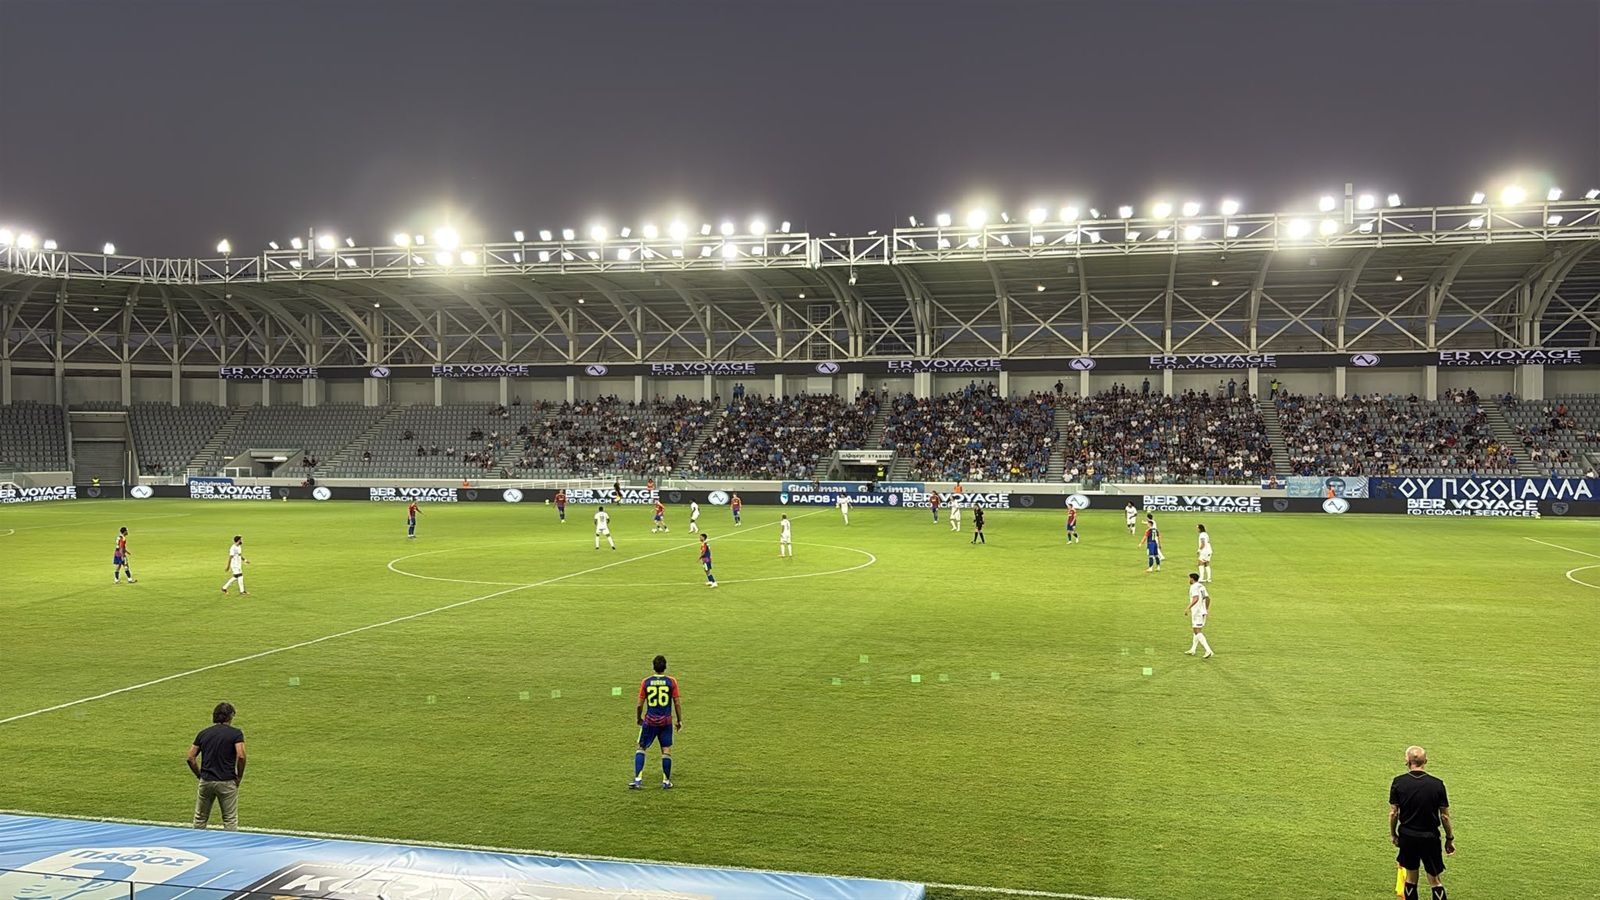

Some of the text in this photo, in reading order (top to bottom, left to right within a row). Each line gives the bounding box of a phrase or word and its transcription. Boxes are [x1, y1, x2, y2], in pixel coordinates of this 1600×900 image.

[1480, 350, 1582, 359] VOYAGE
[920, 360, 1002, 368] VOYAGE
[1186, 355, 1276, 364] VOYAGE
[20, 486, 76, 497] VOYAGE
[218, 486, 271, 495] VOYAGE
[399, 488, 458, 496] VOYAGE
[1398, 478, 1434, 499] ΟΥ
[1442, 478, 1516, 500] ΠΟΣΟΙ
[792, 495, 830, 503] PAFOS
[1182, 496, 1261, 506] VOYAGE
[1450, 499, 1538, 510] VOYAGE
[646, 686, 670, 707] 26
[69, 850, 196, 866] ΠΑΦΟΣ
